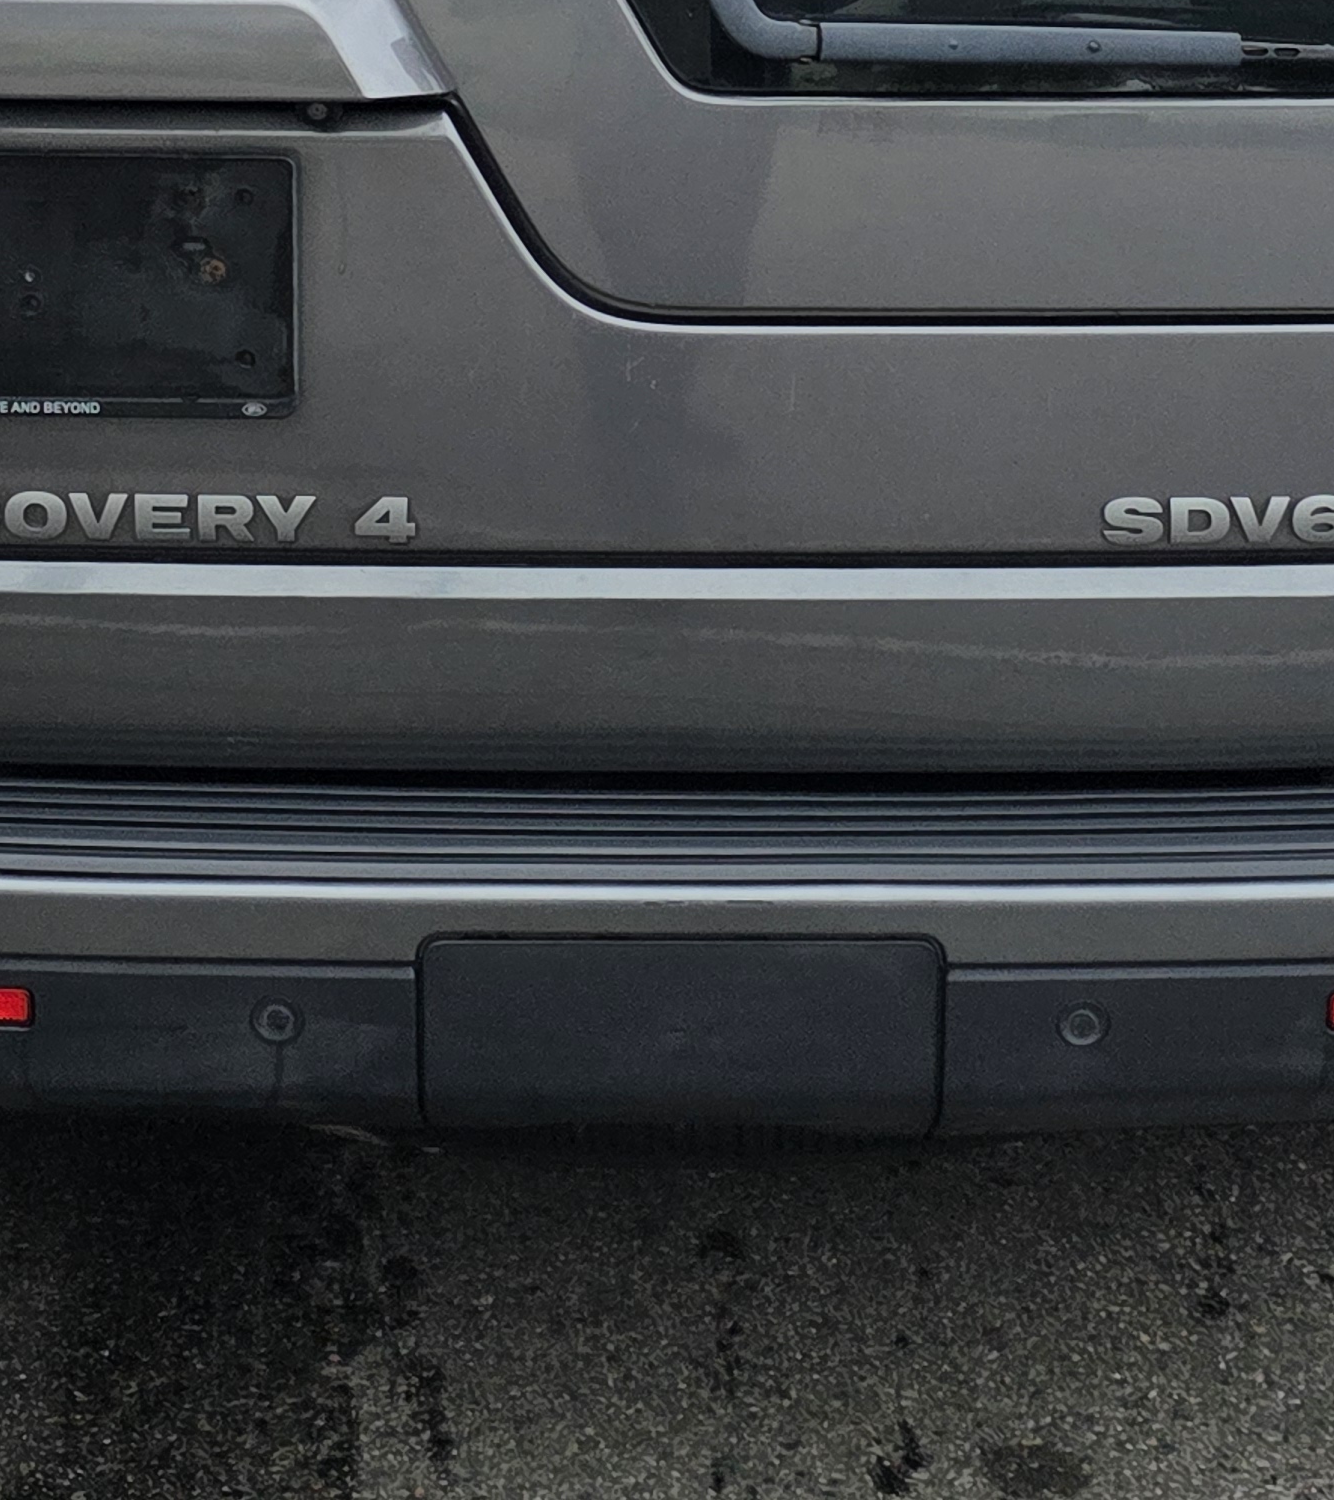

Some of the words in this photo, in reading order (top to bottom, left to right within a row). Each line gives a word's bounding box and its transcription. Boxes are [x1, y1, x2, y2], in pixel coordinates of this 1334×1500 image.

[10, 401, 41, 414] AND
[43, 402, 101, 414] BEYOND
[354, 496, 416, 543] 4
